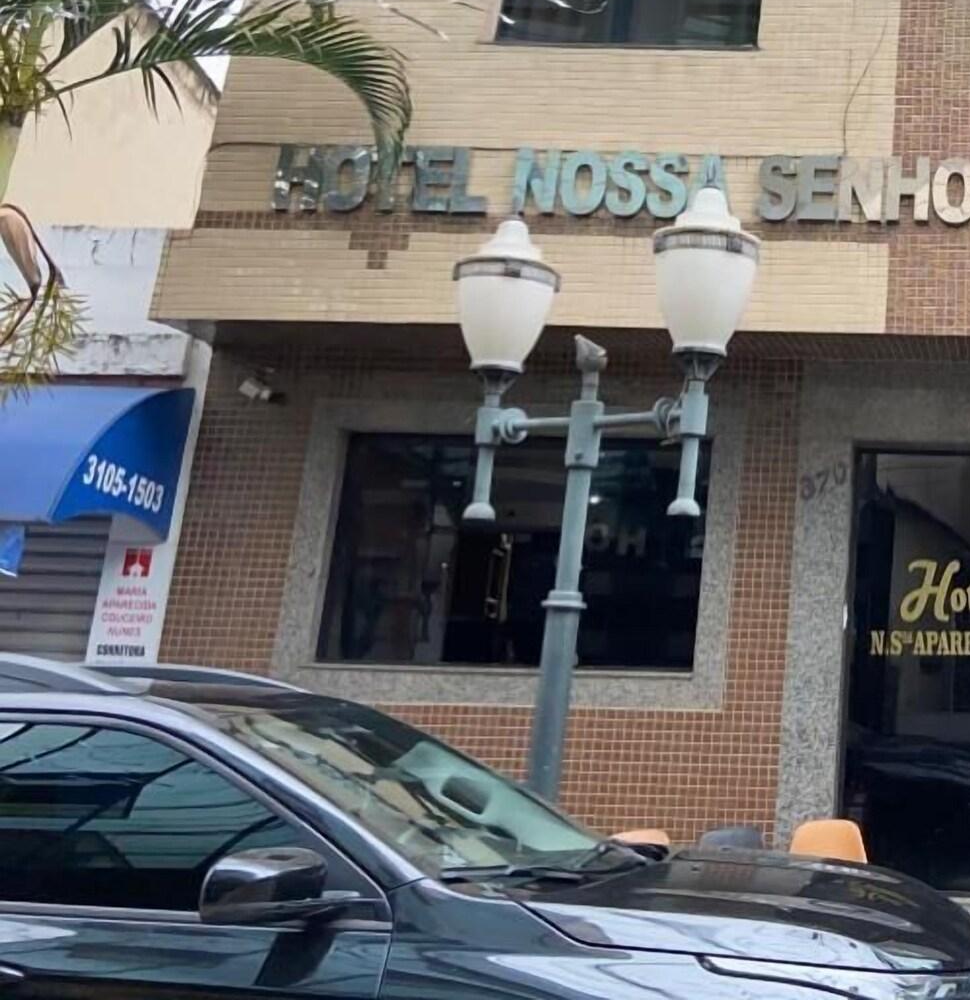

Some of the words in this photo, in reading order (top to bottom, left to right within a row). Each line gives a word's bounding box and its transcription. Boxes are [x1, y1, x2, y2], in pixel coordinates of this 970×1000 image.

[272, 144, 487, 214] HOTEL
[511, 147, 734, 219] NOSSA
[83, 454, 164, 513] 3105-1503
